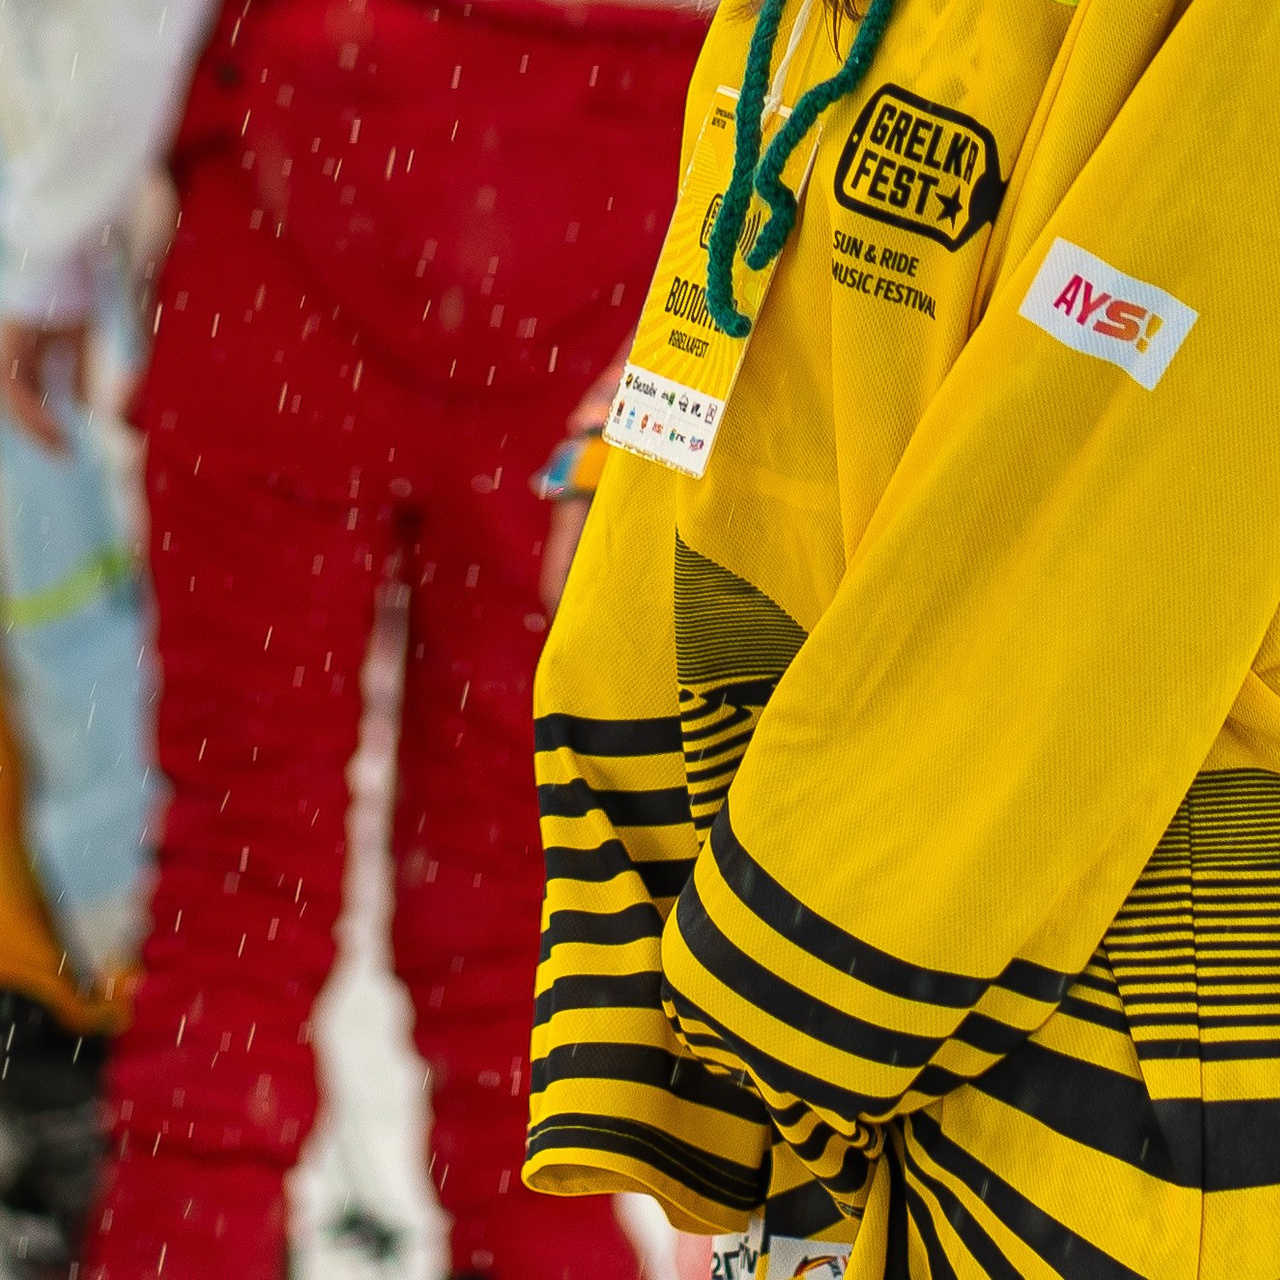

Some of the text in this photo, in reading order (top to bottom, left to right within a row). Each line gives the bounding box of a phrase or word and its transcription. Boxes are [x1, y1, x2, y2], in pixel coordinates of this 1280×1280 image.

[870, 103, 980, 186] GRELKA
[851, 149, 940, 216] FEST
[833, 230, 920, 277] SUN & RIDE
[873, 277, 936, 320] FESTIVAL
[1053, 273, 1164, 354] AYS!
